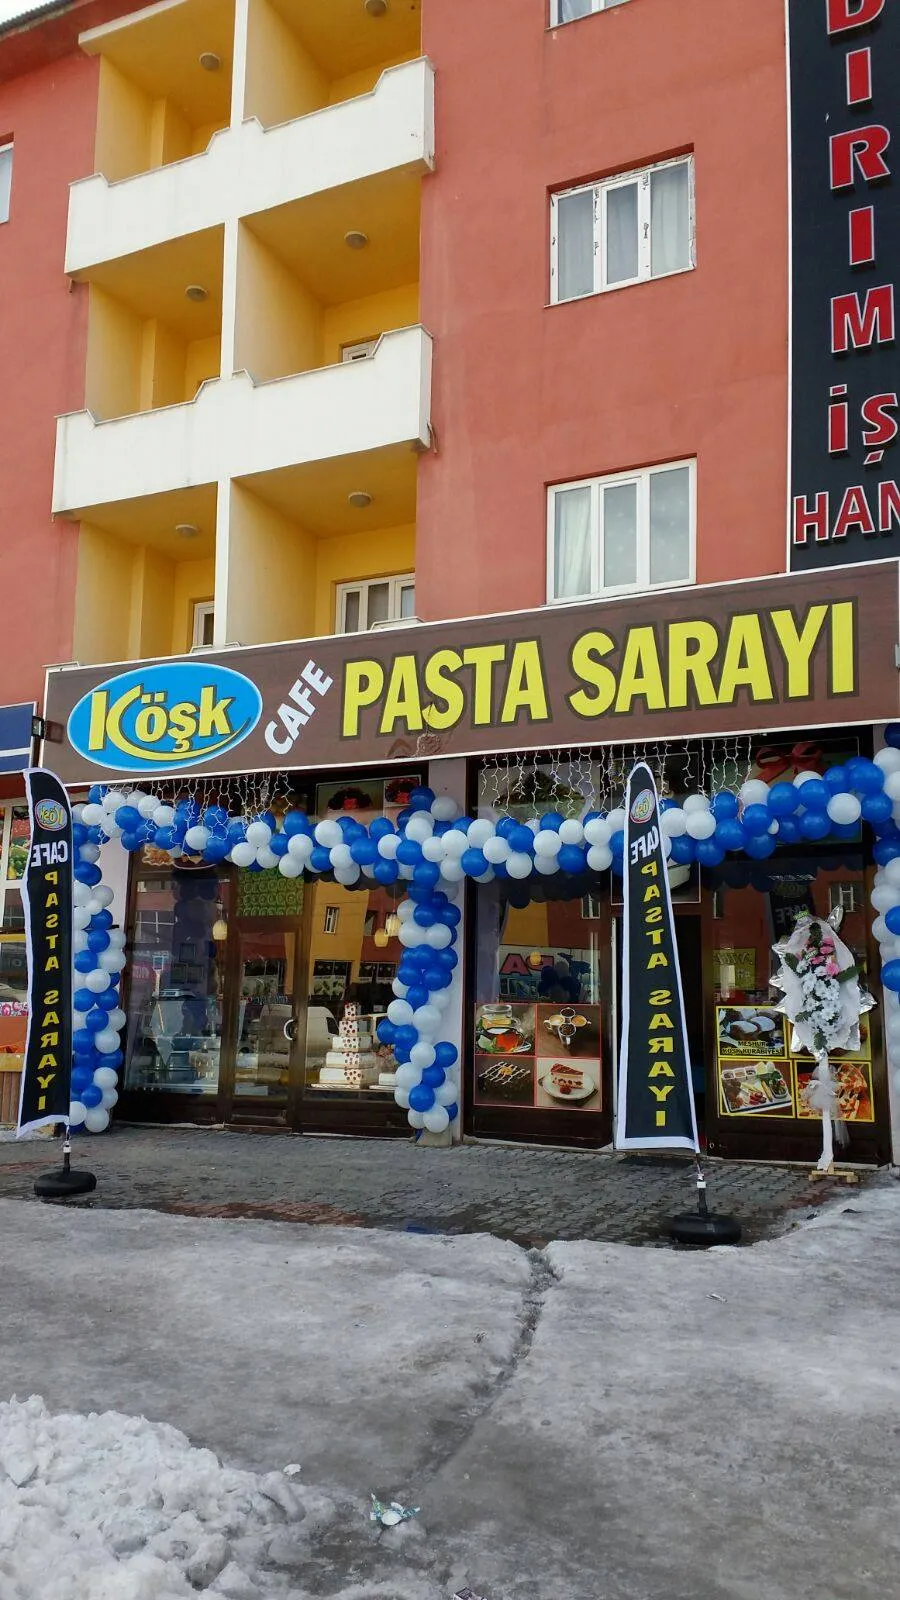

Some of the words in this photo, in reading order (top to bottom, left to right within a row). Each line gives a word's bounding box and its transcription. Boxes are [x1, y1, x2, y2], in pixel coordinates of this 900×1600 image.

[88, 683, 245, 762] Köşk
[264, 659, 334, 755] CAFE
[341, 639, 550, 737] PASTA
[568, 600, 856, 718] SARAYI
